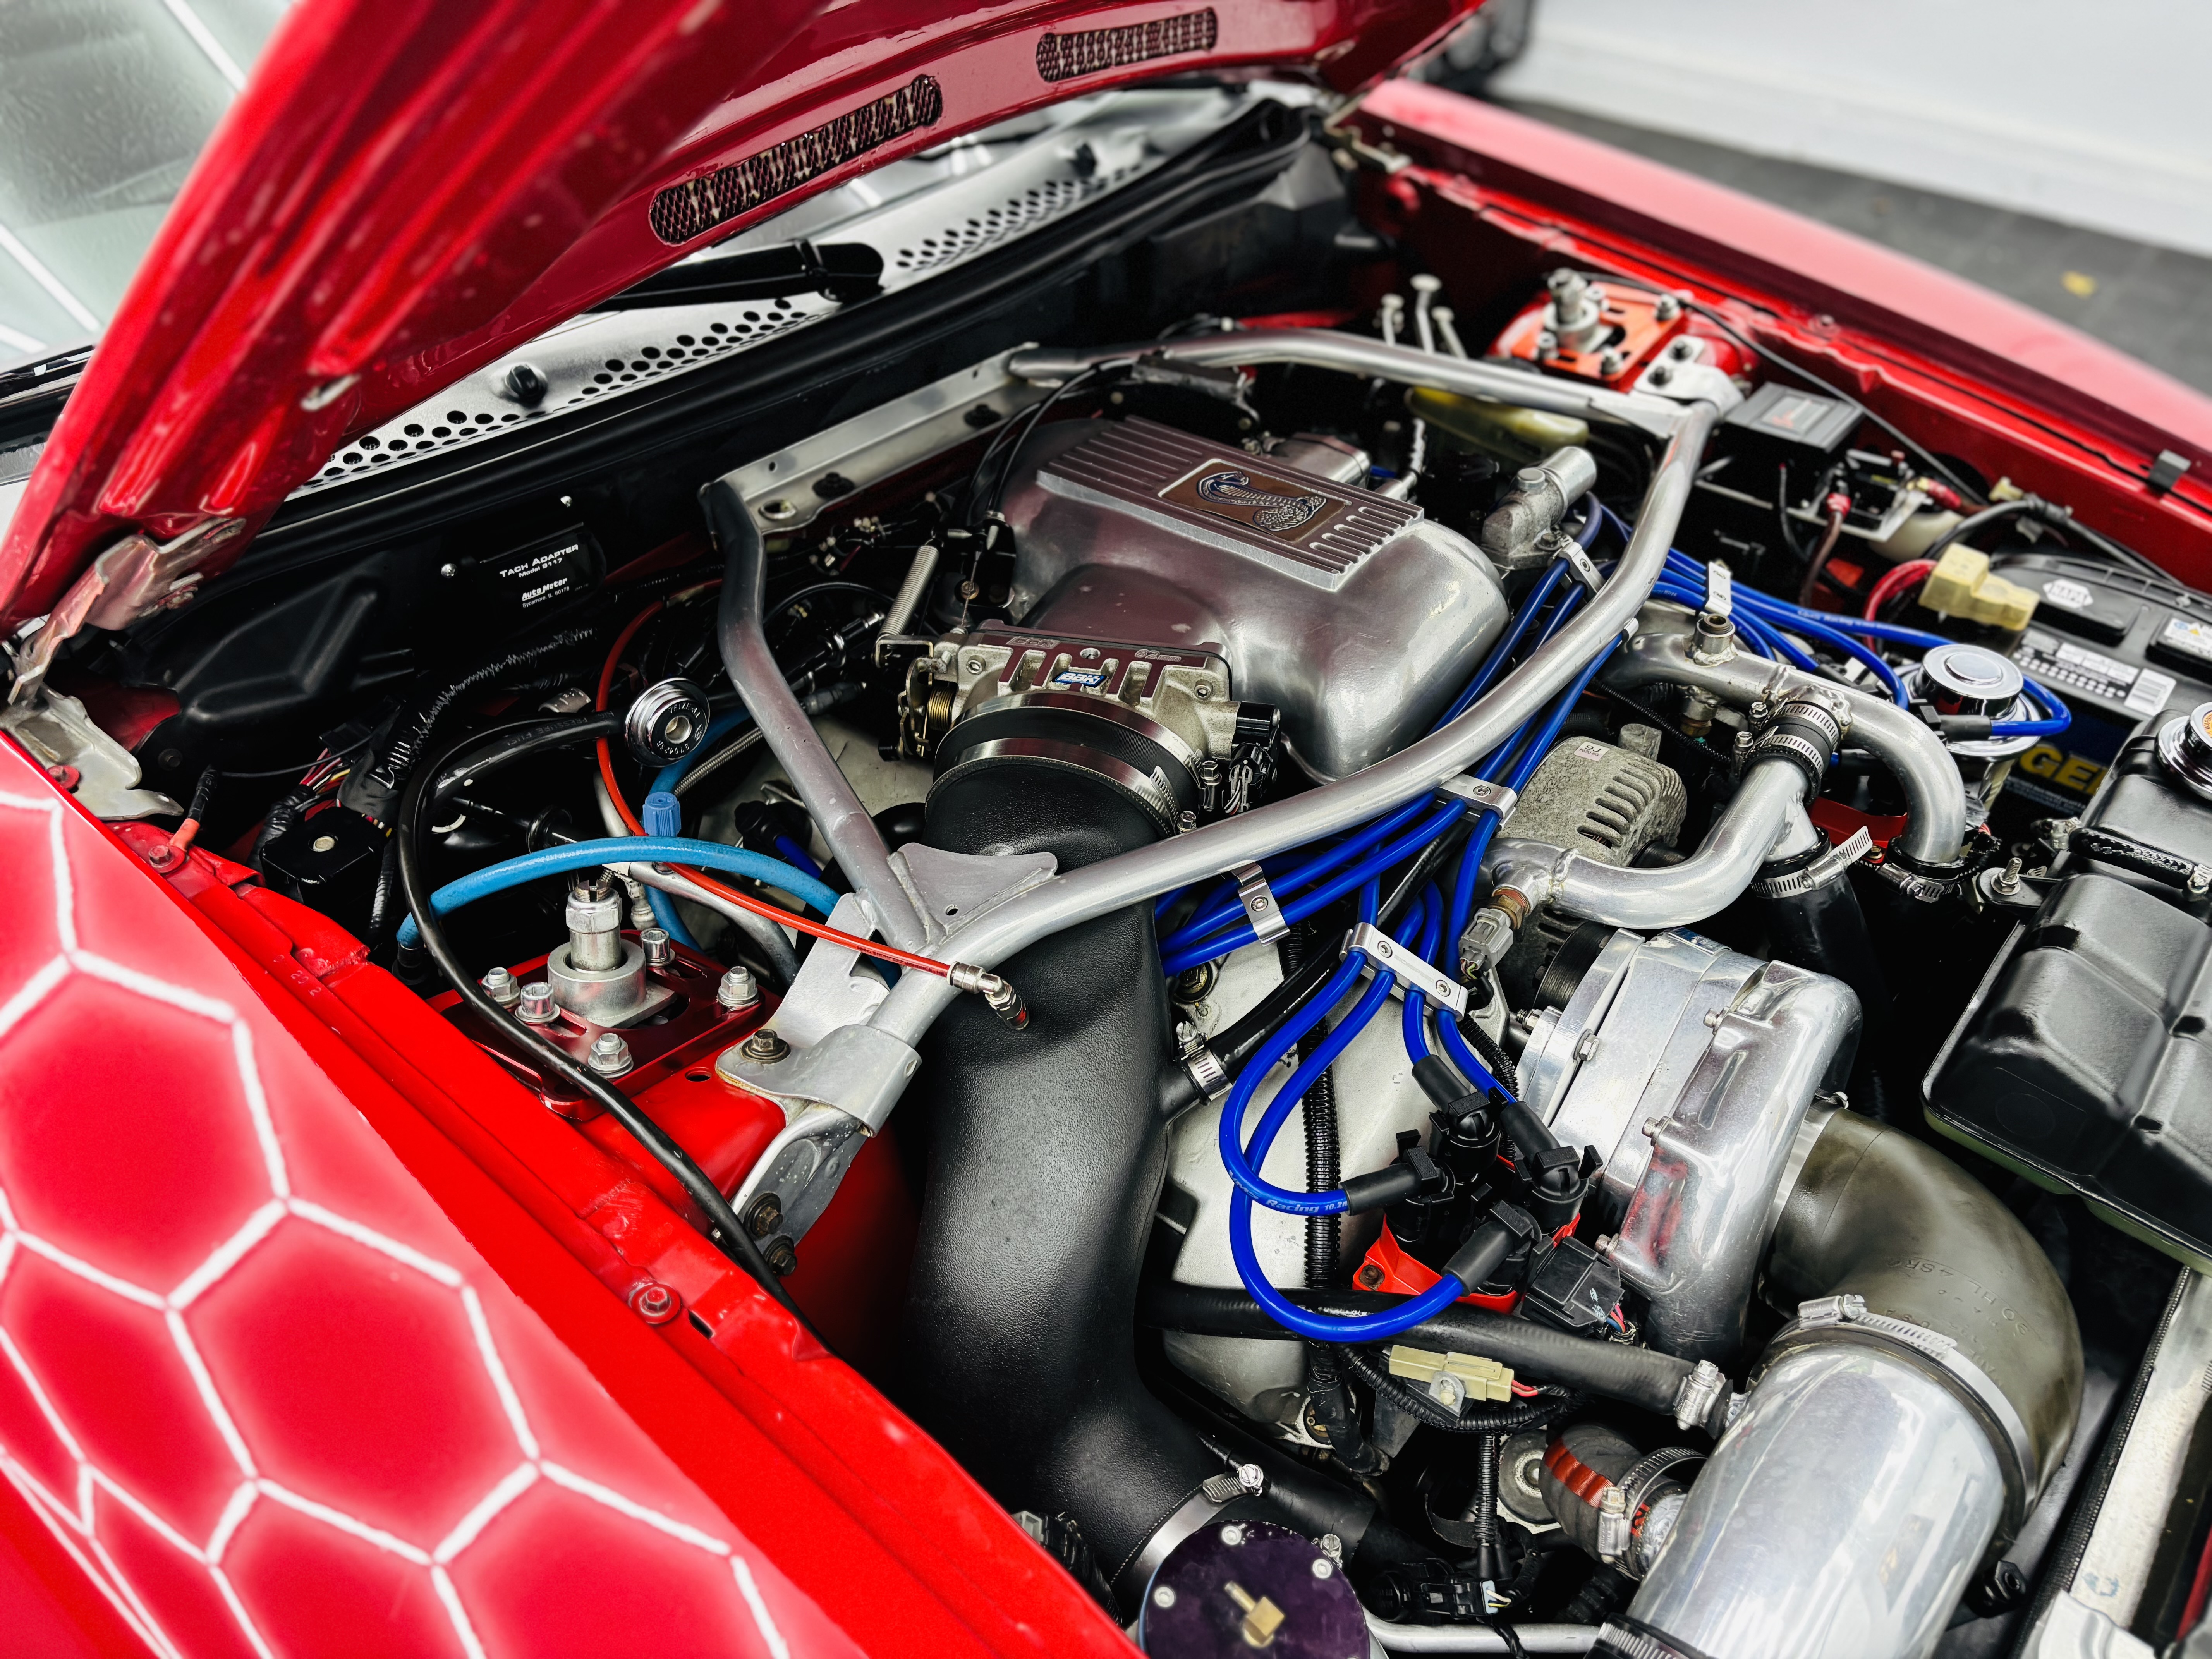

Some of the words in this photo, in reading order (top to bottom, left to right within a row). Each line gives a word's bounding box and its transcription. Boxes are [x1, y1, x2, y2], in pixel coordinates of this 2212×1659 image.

[500, 563, 528, 577] TACH
[532, 544, 578, 566] ADAPTER
[519, 566, 540, 577] Model
[1134, 649, 1182, 662] 62mm
[1057, 672, 1101, 685] BBK
[1266, 1199, 1320, 1213] Racing
